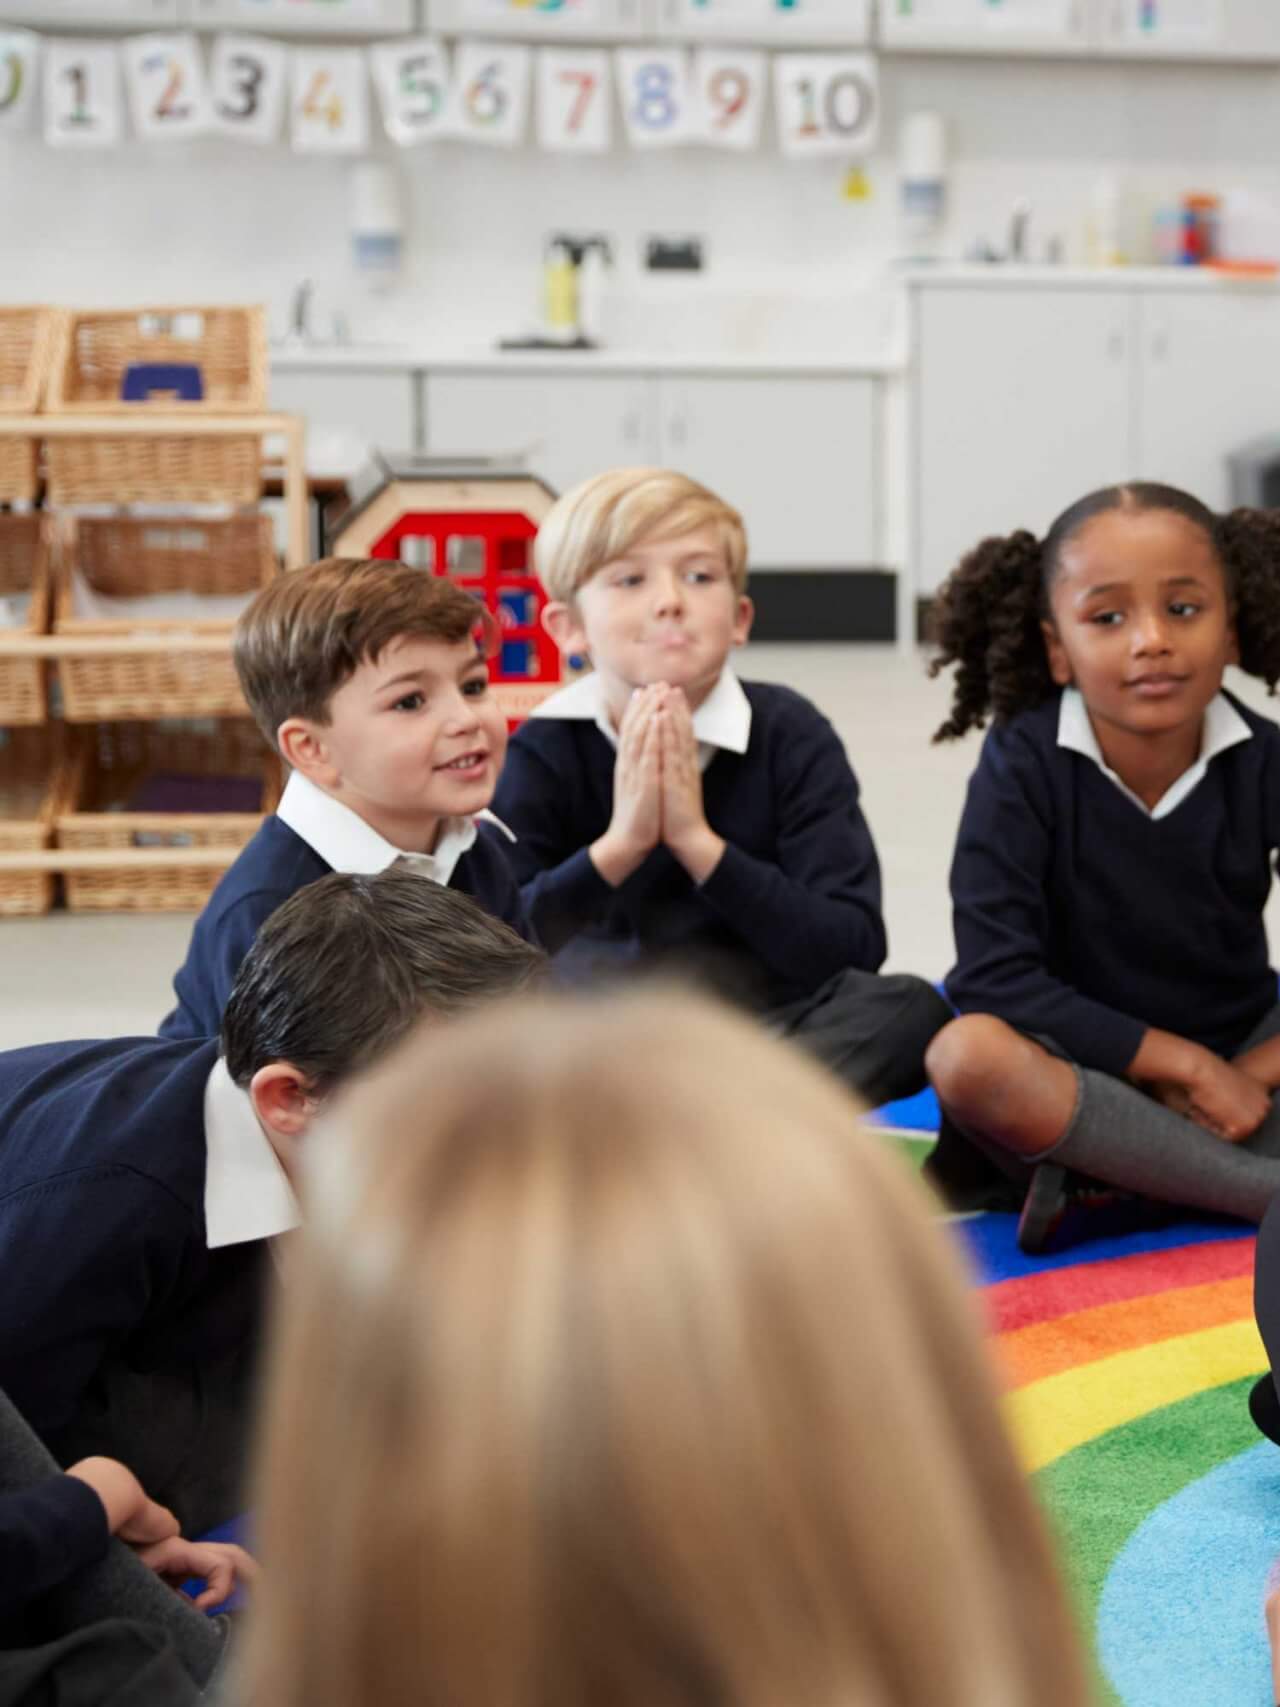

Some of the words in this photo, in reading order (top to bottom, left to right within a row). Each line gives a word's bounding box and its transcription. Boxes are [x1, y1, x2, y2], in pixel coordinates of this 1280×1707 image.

[62, 63, 95, 129] 1
[142, 53, 190, 119] 2
[218, 54, 264, 121] 3
[303, 68, 342, 129] 4
[400, 53, 443, 124] 5
[464, 62, 507, 126] 6
[558, 68, 596, 135] 7
[633, 63, 677, 130] 8
[708, 68, 750, 130] 9
[796, 72, 875, 138] 10
